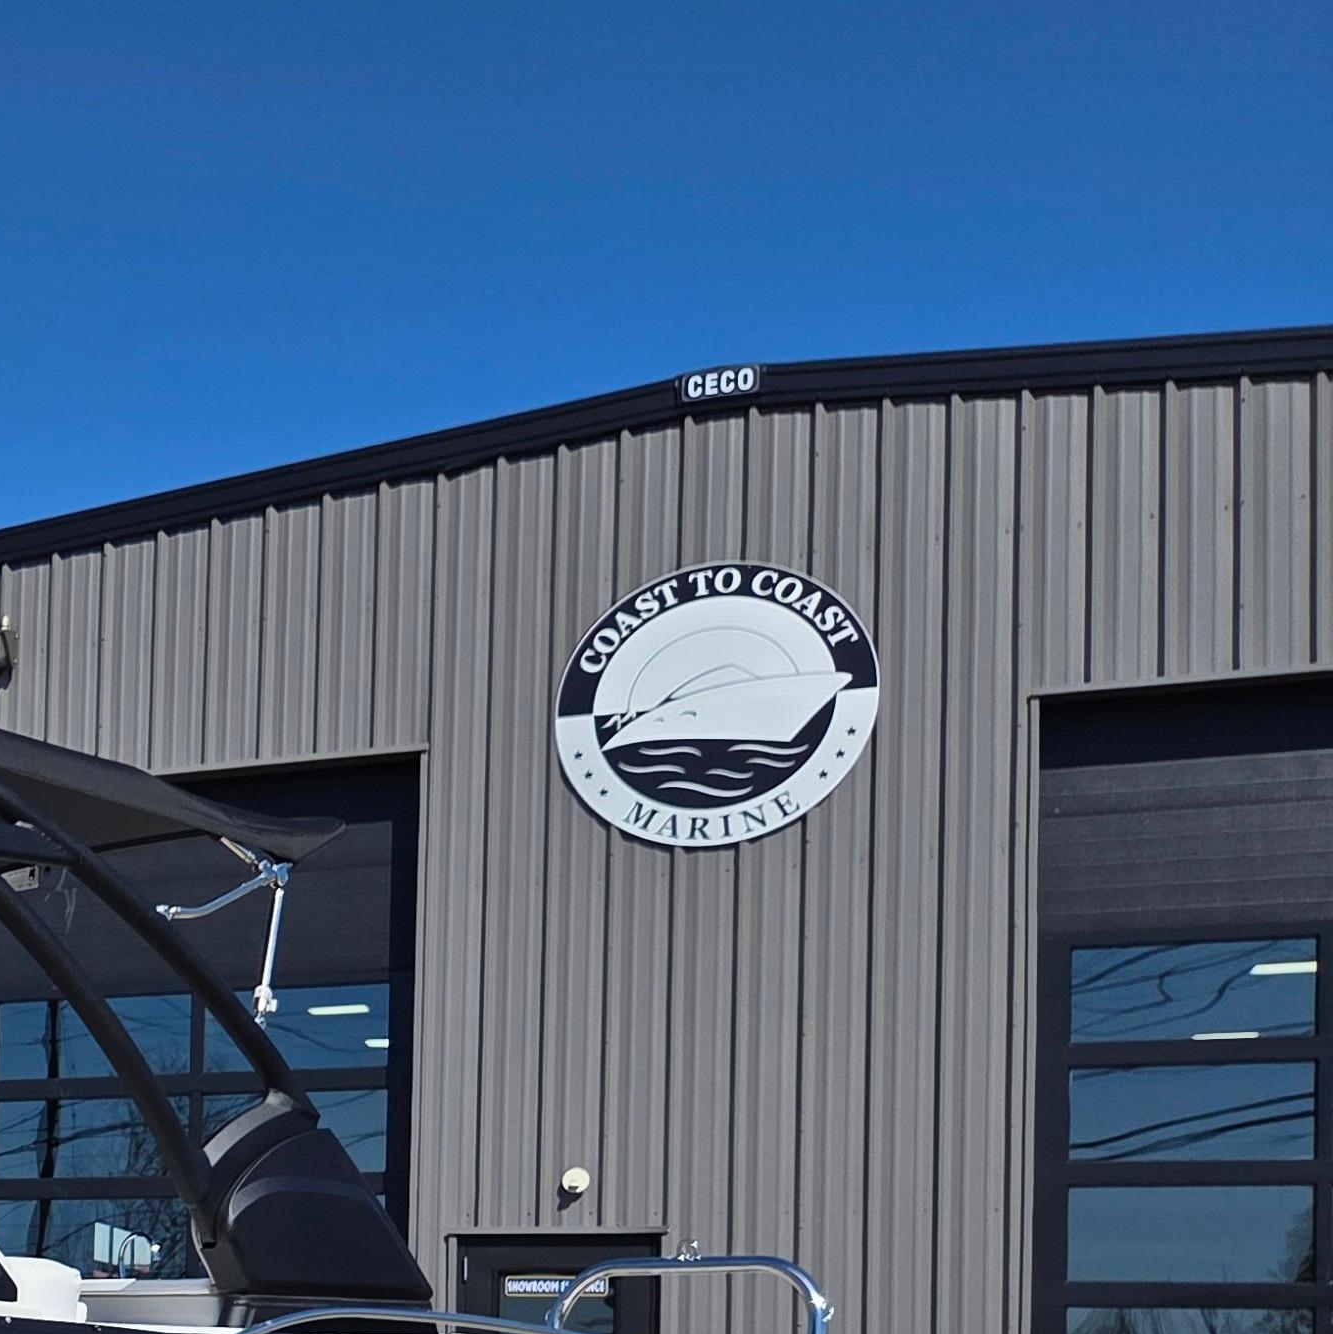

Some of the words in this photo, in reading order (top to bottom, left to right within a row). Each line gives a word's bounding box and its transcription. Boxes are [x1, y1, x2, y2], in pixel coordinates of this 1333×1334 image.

[687, 367, 754, 398] CECO
[579, 579, 679, 674] COAST
[688, 567, 742, 597] TO
[751, 569, 859, 647] COAST
[622, 790, 801, 840] MARINE
[507, 1280, 559, 1293] SHOWROOM
